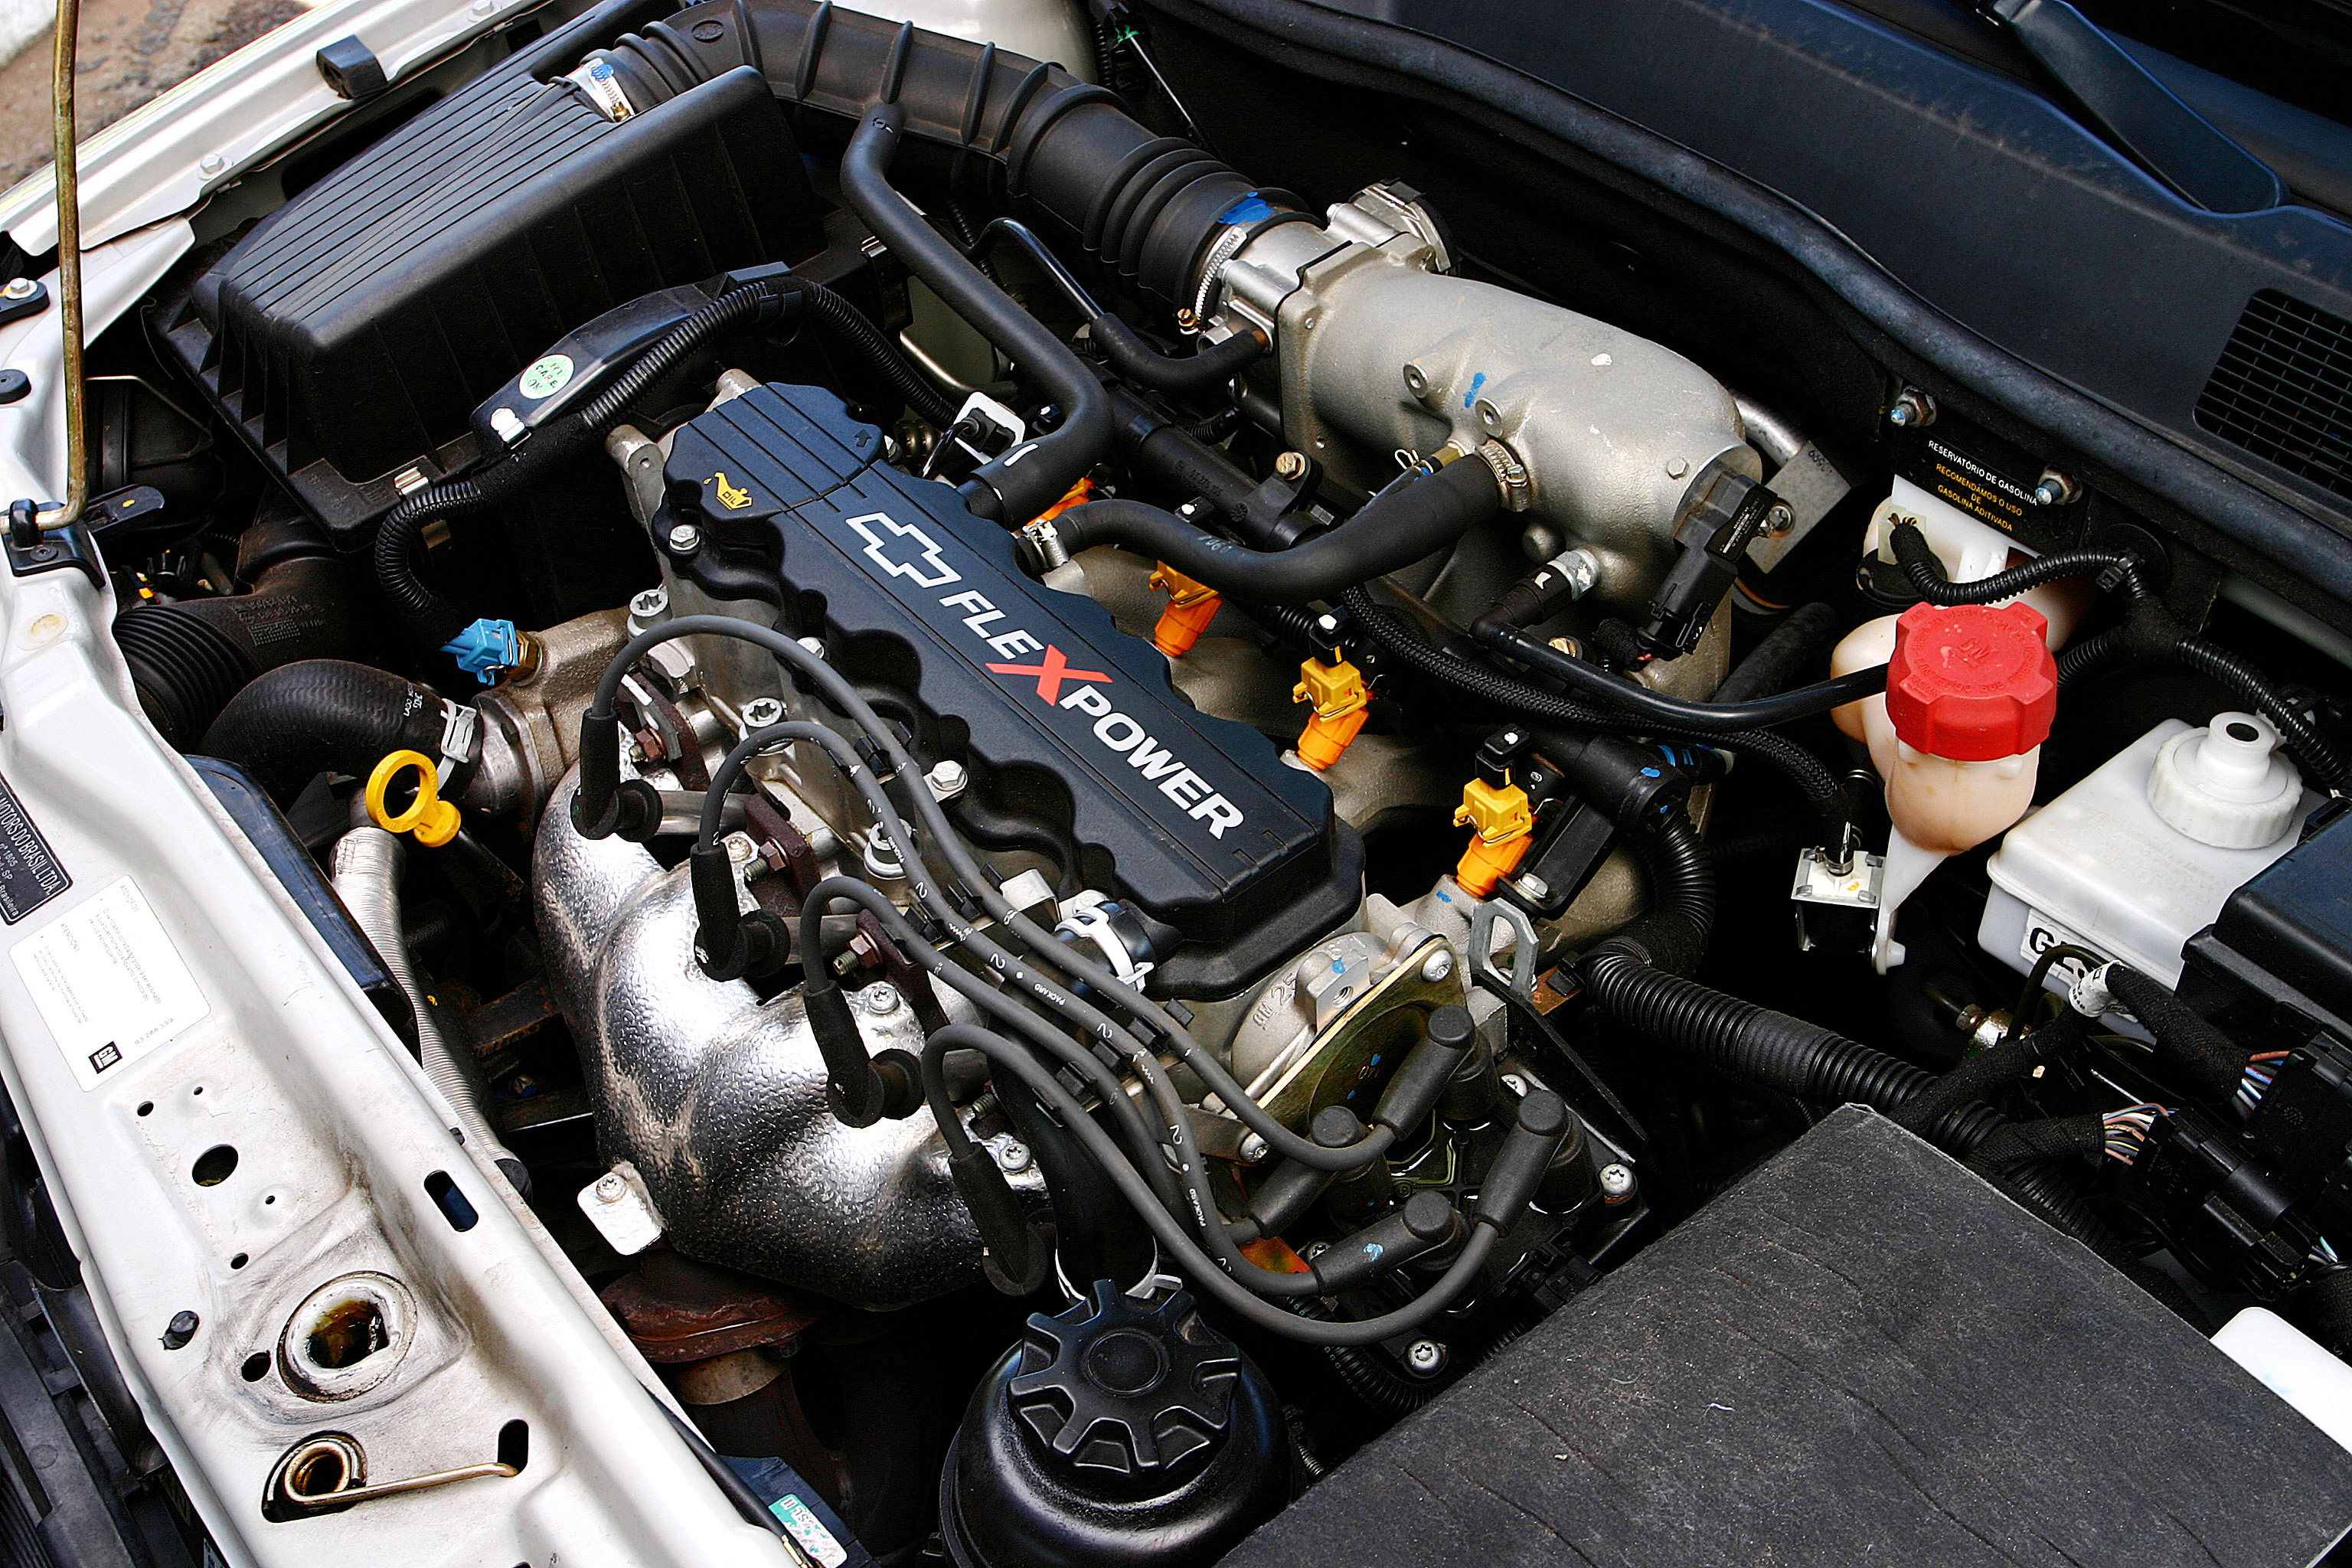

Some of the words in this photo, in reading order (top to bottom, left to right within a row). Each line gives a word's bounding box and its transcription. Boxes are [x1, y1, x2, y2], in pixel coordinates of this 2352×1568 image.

[1929, 440, 1985, 477] RESERVATÓRIO
[1986, 472, 1998, 485] DE
[1998, 479, 2037, 506] GASOLINA
[722, 491, 737, 505] OIL
[1936, 463, 1998, 502] RECOMENDAMOS
[1998, 498, 2006, 507] O
[2006, 501, 2023, 516] USO
[1971, 492, 1982, 505] DE
[1938, 485, 1974, 510] GASOLINA
[1975, 505, 2013, 531] ADITIVADA
[11, 828, 31, 847] DO
[18, 839, 47, 874] BRASIL
[2, 869, 13, 880] SP
[1034, 983, 1066, 1005] PACKARD
[98, 1045, 119, 1067] GM
[1189, 1188, 1207, 1227] PACKARD
